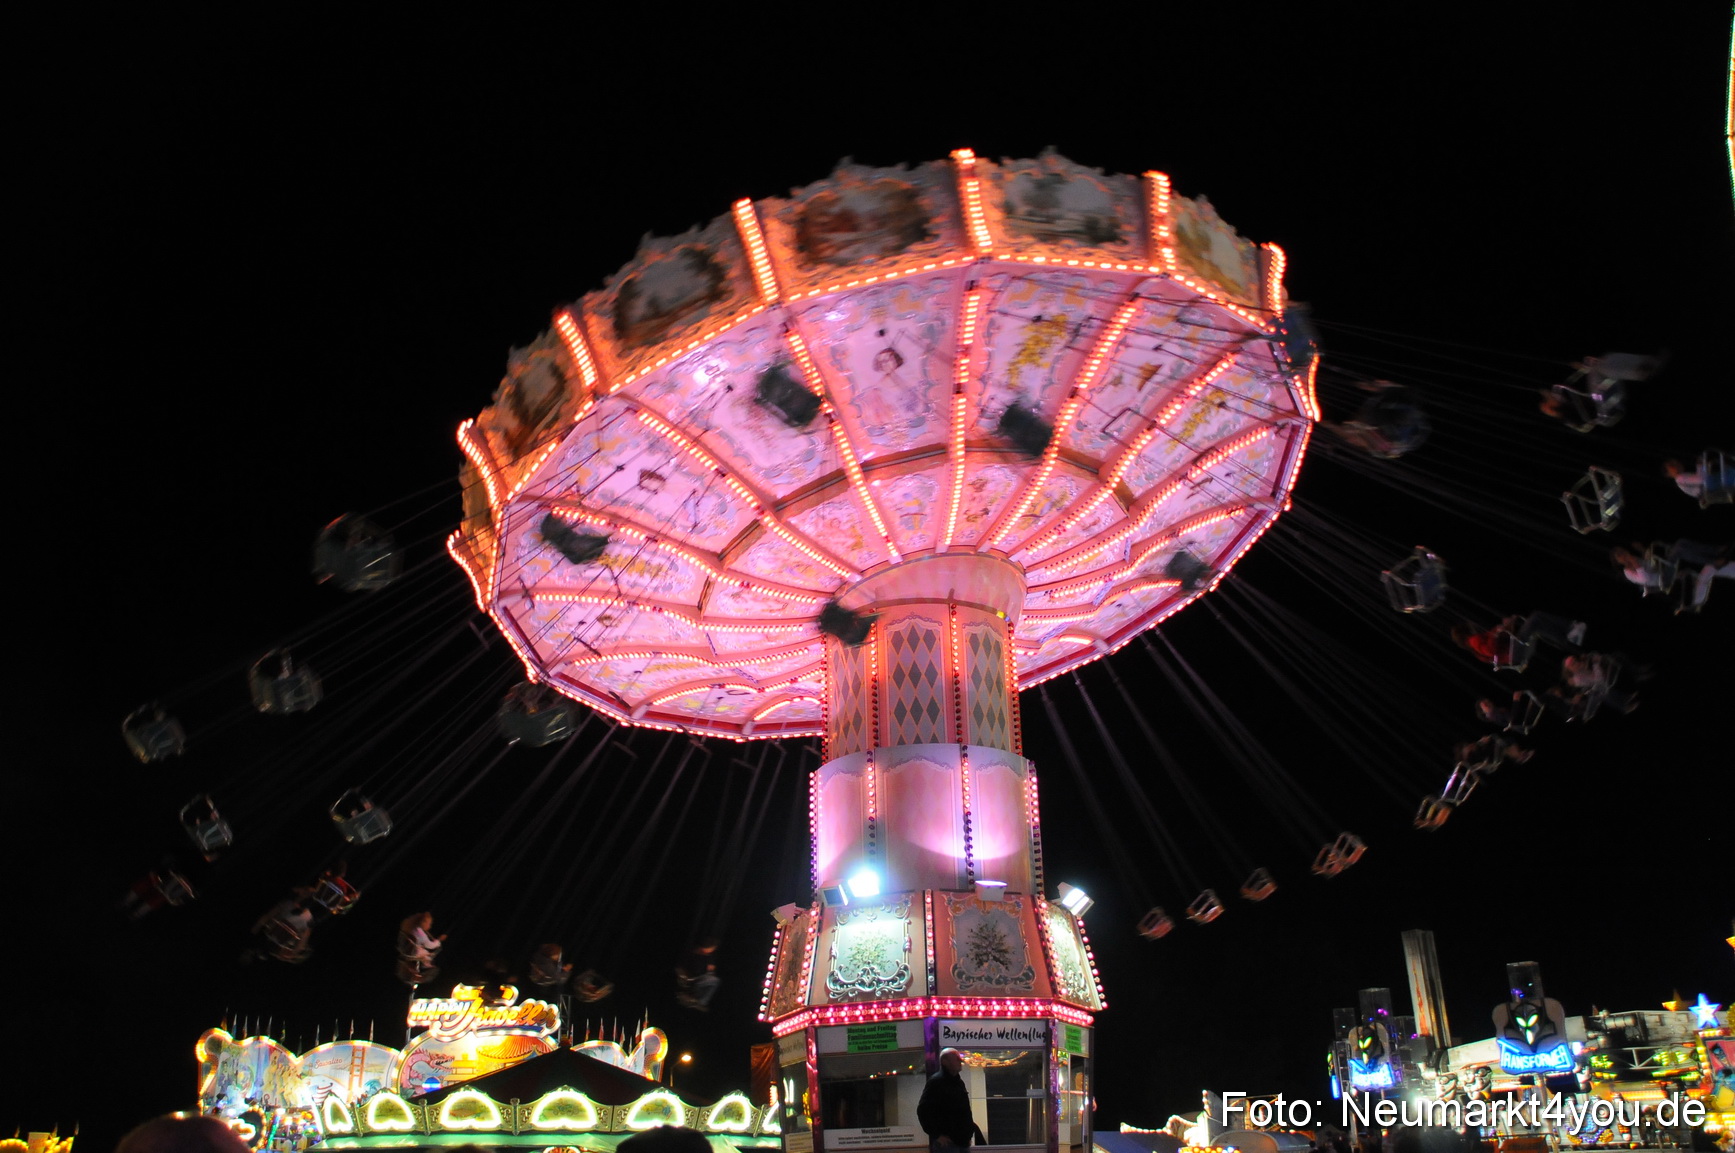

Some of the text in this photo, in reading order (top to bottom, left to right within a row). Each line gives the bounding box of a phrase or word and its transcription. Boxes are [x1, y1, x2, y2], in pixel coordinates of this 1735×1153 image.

[410, 1001, 470, 1027] HAPPY
[943, 1026, 1047, 1042] Bayrischer Wellenflug
[1497, 1039, 1572, 1070] TRANSFORMER
